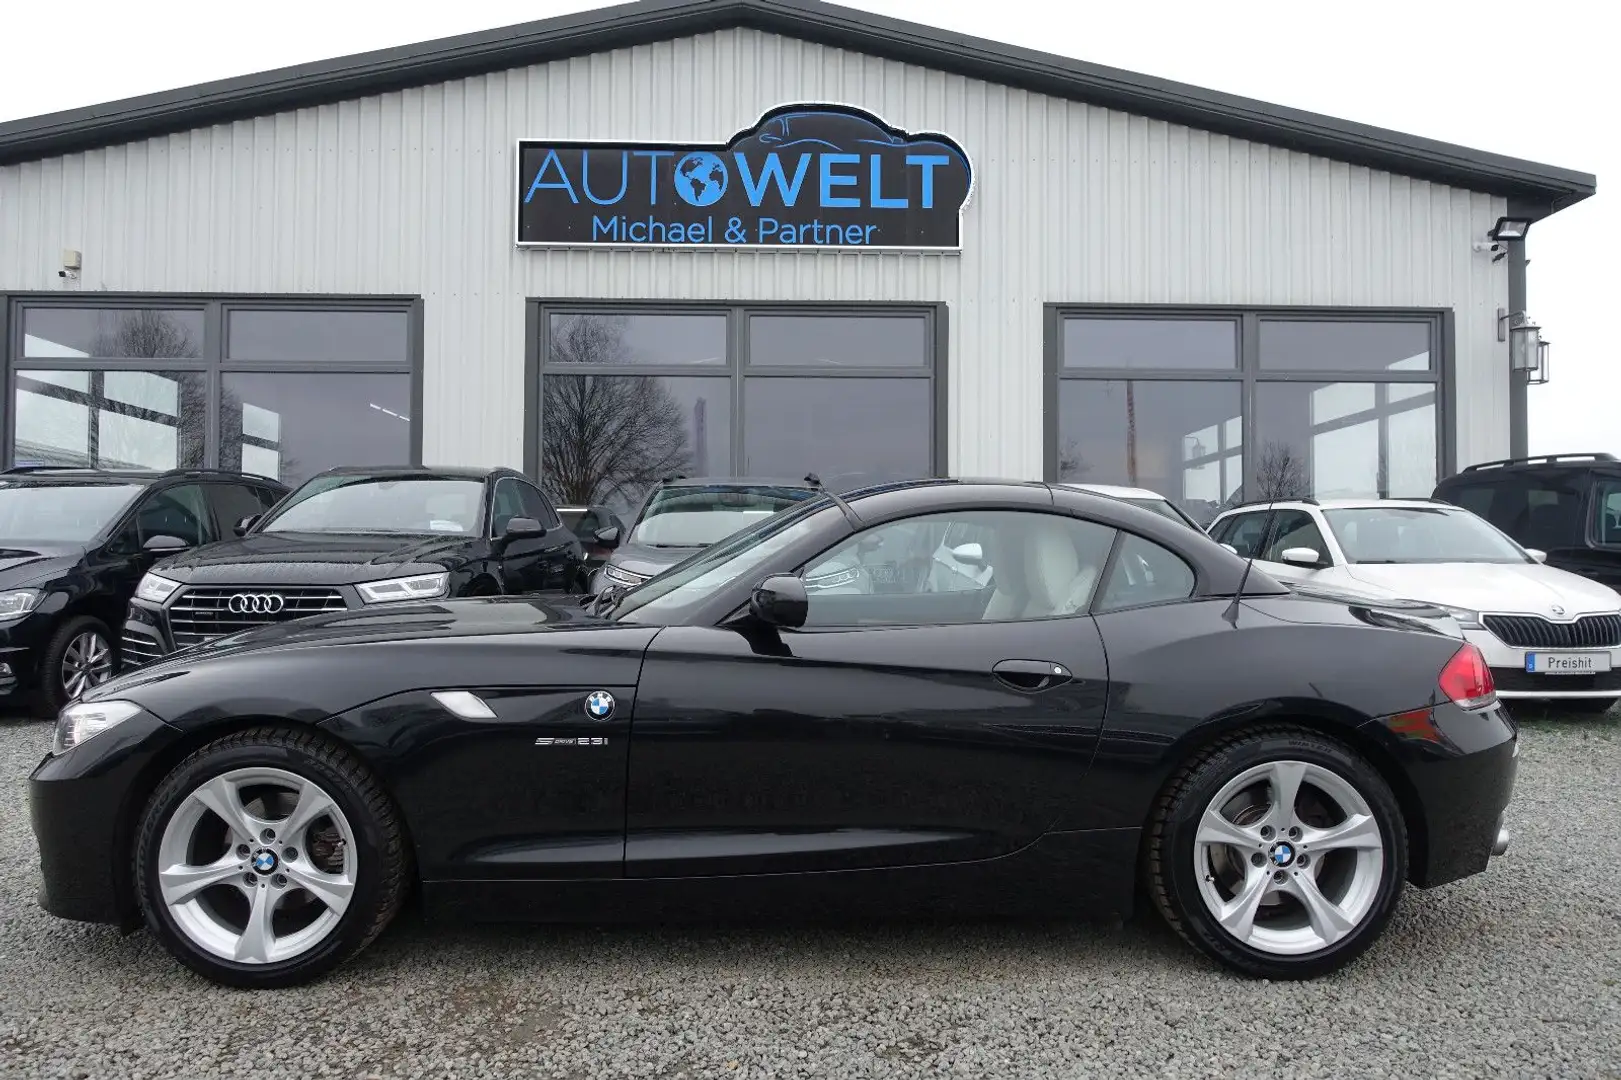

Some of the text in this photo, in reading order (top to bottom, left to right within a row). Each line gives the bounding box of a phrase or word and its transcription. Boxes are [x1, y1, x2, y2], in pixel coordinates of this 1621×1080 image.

[592, 215, 877, 245] Michael & Partner
[1548, 656, 1592, 669] Preishit
